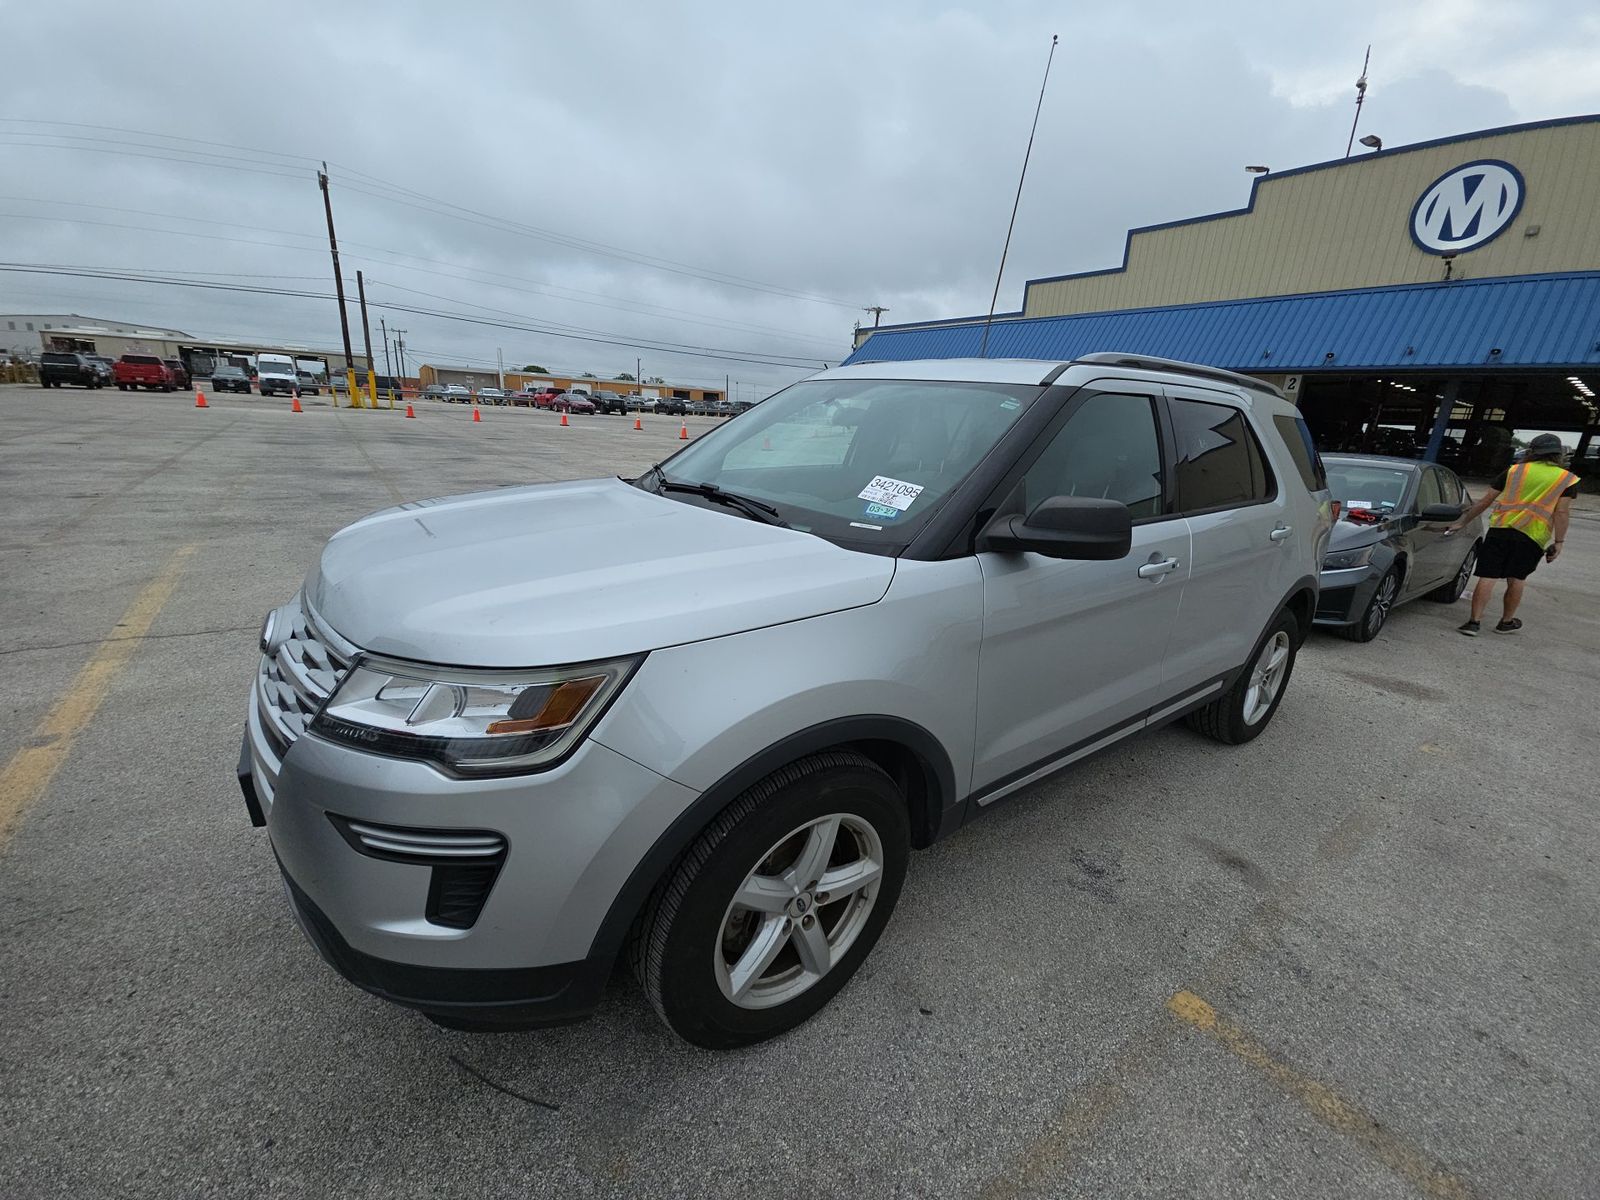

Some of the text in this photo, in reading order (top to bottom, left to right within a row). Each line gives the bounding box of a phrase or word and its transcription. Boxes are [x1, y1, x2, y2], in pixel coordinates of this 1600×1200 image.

[1416, 168, 1514, 248] M
[1287, 377, 1297, 390] 2
[870, 478, 921, 499] 3421095
